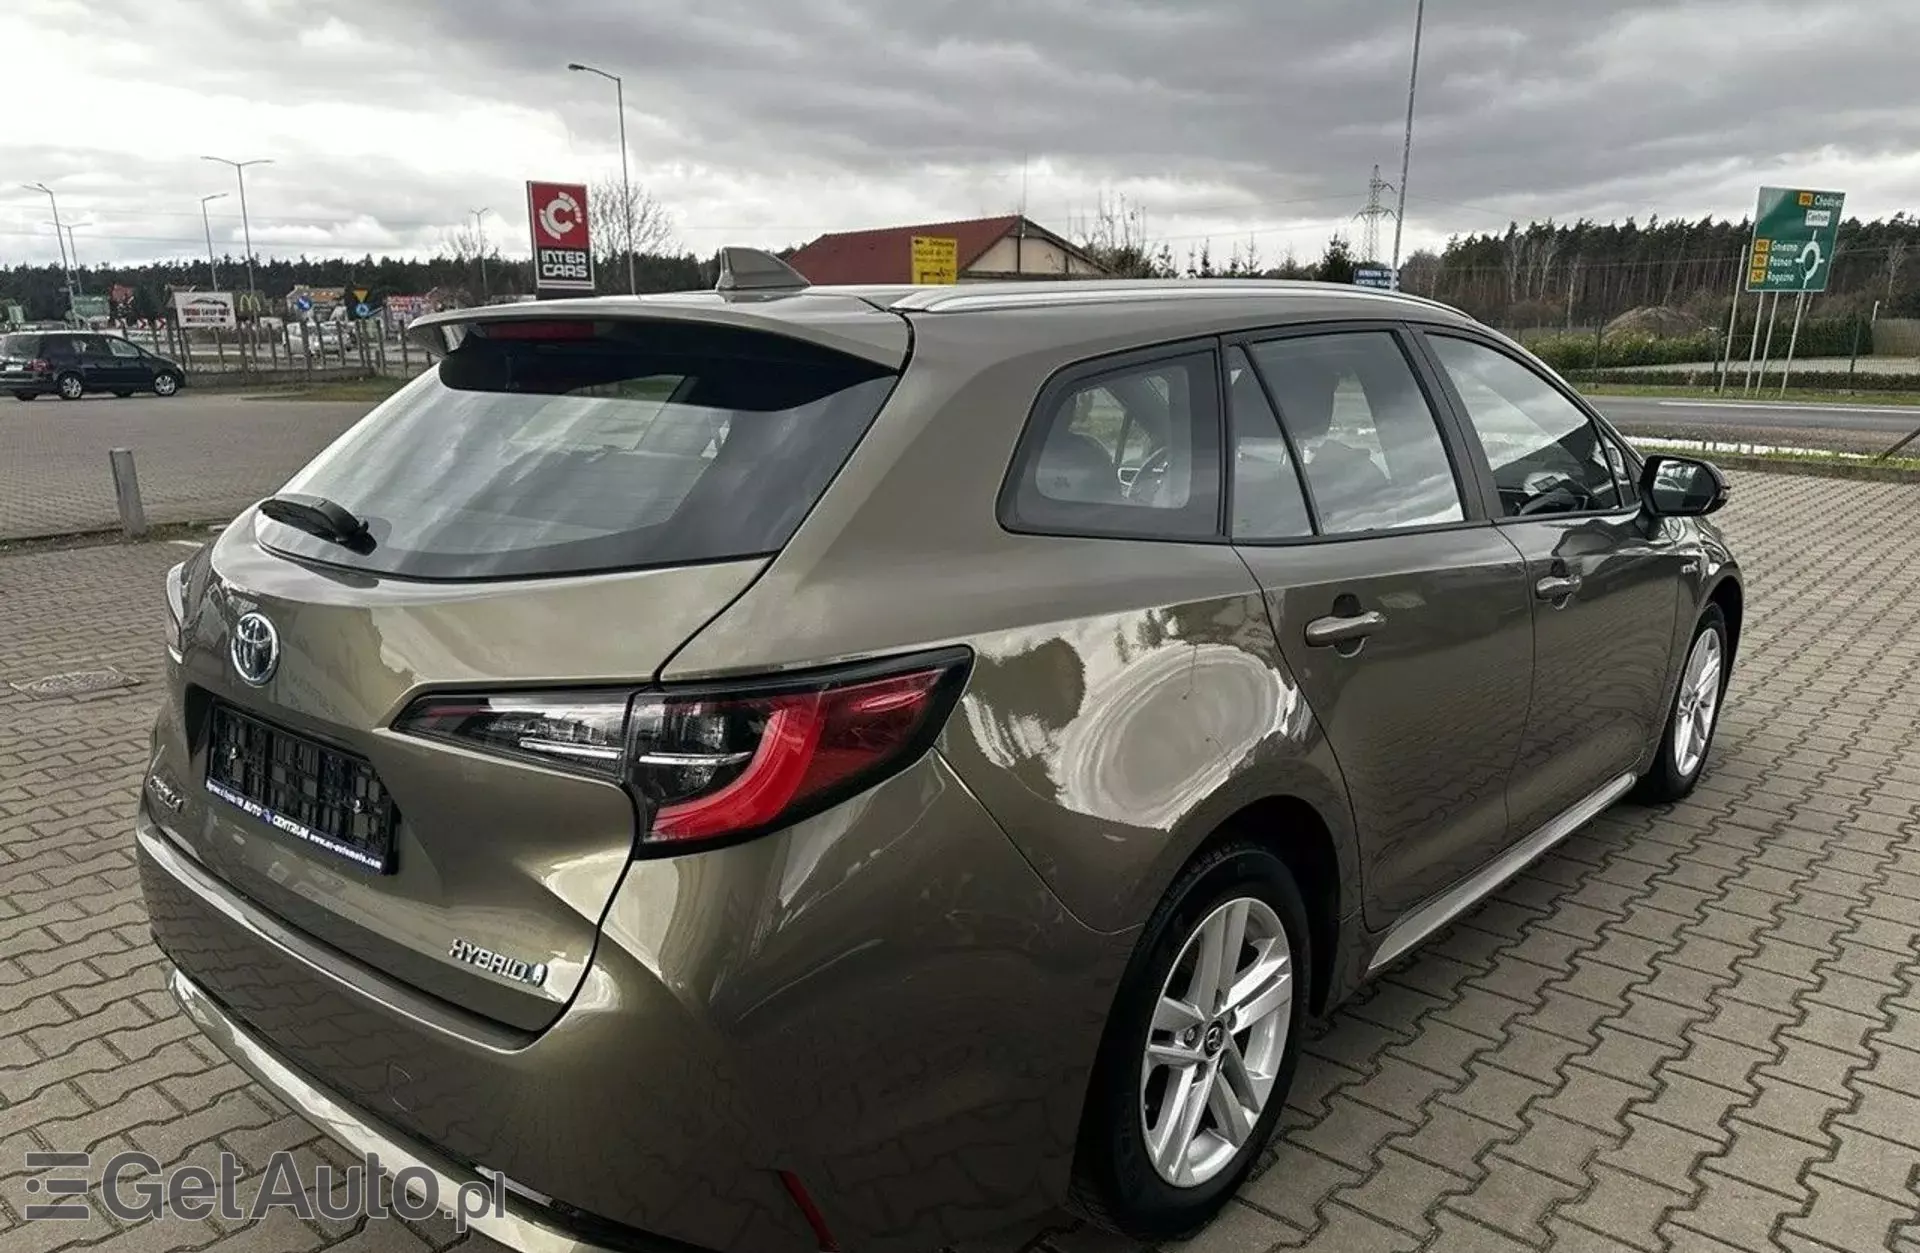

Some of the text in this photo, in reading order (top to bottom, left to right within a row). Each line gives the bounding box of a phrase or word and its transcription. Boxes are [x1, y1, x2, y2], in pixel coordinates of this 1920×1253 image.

[541, 249, 586, 264] INTER
[542, 264, 588, 278] CARS
[272, 814, 309, 840] CENTRUM
[448, 939, 528, 981] HYBRID
